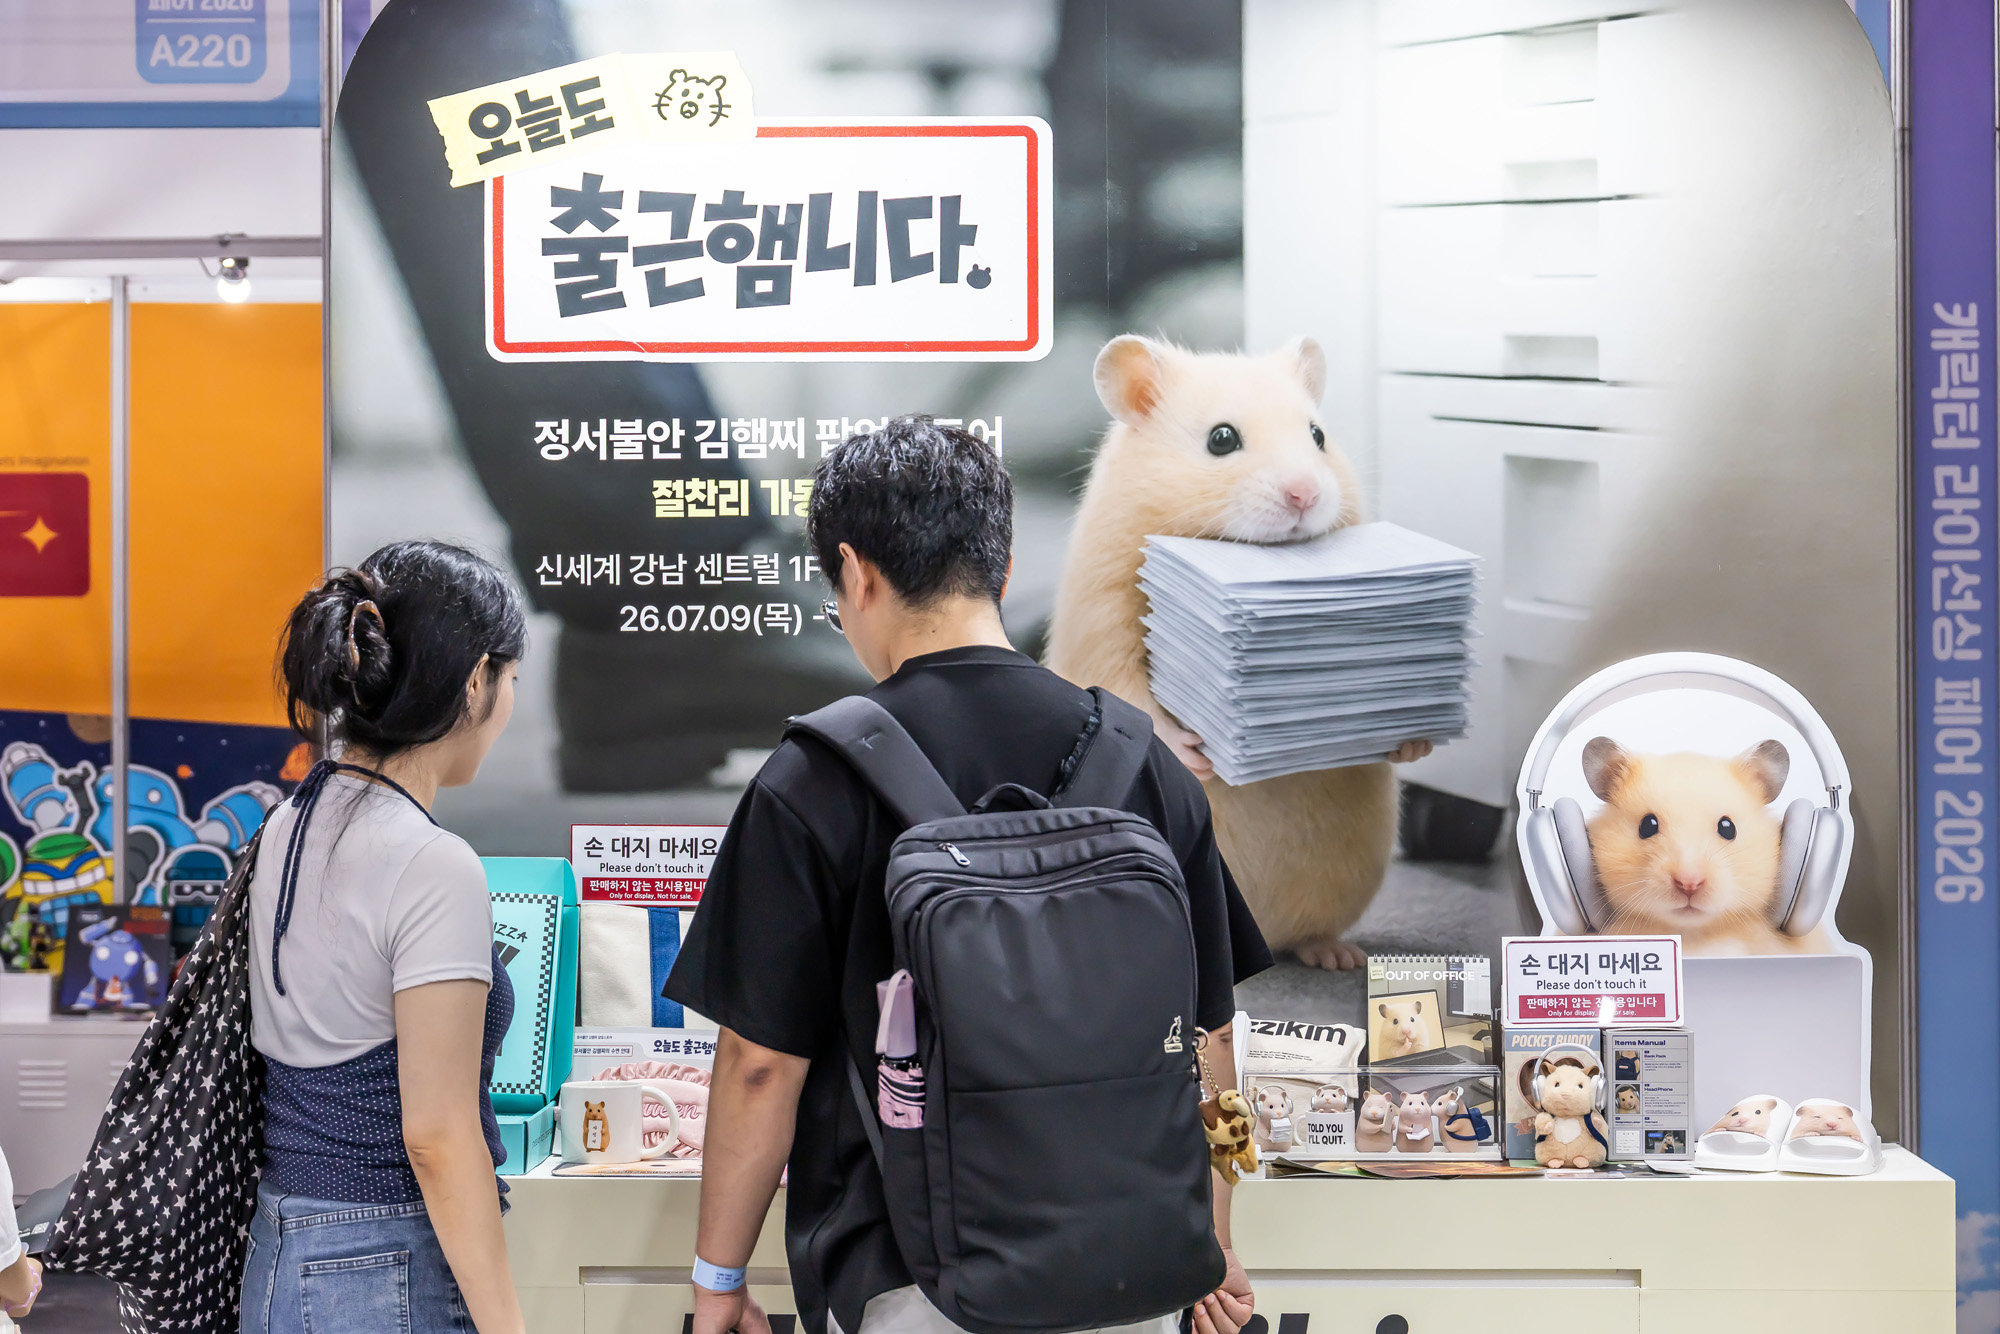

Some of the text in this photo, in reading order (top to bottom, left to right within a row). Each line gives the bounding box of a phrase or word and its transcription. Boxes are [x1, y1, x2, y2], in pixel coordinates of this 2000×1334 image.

[149, 34, 251, 67] A220
[468, 75, 615, 166] 오늘도
[534, 417, 684, 461] 정서불안
[694, 416, 805, 460] 김햄찌
[652, 478, 749, 518] 절찬리
[535, 553, 822, 586] 신세계 강남 센트럴 1F
[1931, 302, 1985, 904] 캐릭터 라이선싱 페어 2026
[619, 602, 803, 636] 26.07.09(목)
[584, 837, 718, 859] 손 대지 마세요
[600, 862, 704, 873] Please don't touch it
[590, 880, 707, 893] 판매하지 않는 전시용입니
[609, 892, 622, 900] Only
[1520, 952, 1662, 975] 손 대지 마세요
[1385, 970, 1411, 980] OUT
[1414, 970, 1430, 980] OF
[1433, 970, 1475, 981] OFFICE
[1537, 979, 1647, 990] Please don't touch it
[1526, 997, 1657, 1009] 판매하지 않는 전용입니다
[1548, 1009, 1562, 1017] Only
[653, 1039, 680, 1053] 오늘도
[1512, 1034, 1594, 1048] POCKET BUDDY
[1308, 1123, 1344, 1133] TOLD YOU
[1308, 1134, 1346, 1146] I'LL QUIT.
